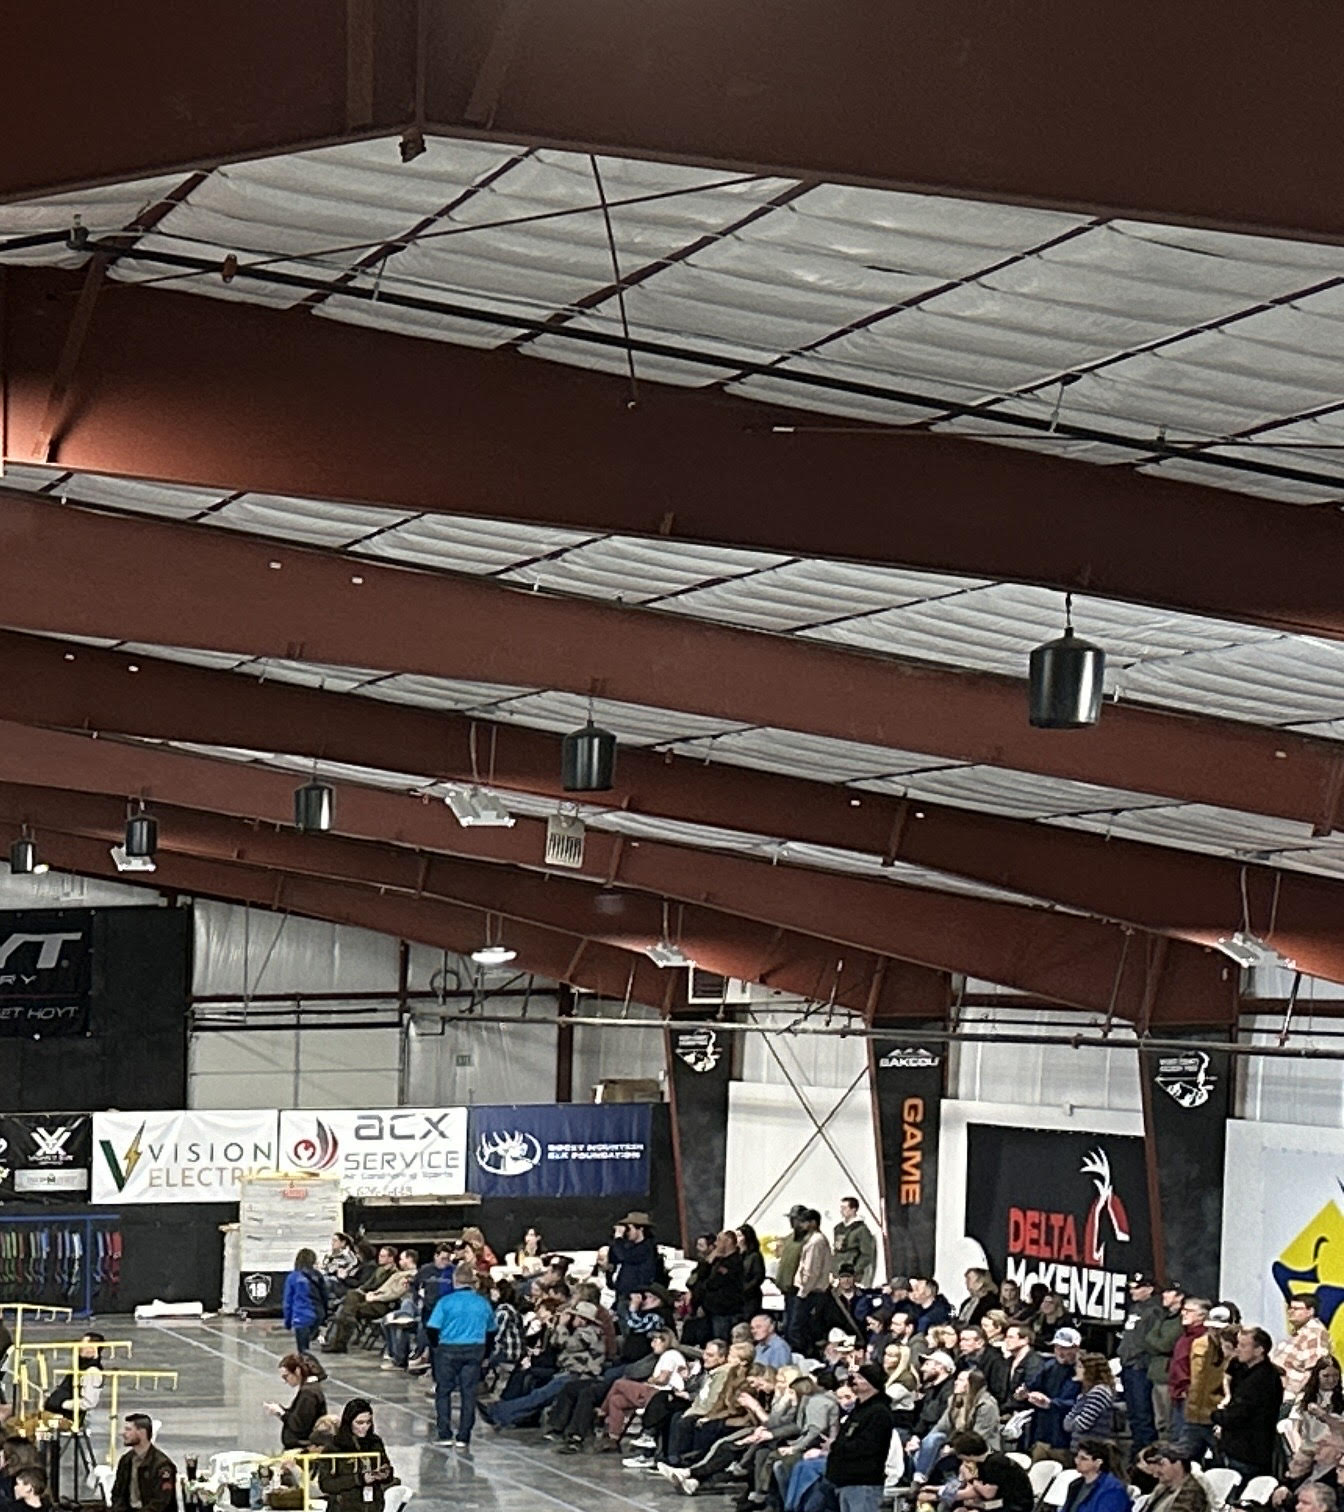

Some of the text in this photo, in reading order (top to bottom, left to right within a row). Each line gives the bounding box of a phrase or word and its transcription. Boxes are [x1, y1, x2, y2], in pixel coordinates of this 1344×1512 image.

[148, 1142, 272, 1162] VISION
[344, 1151, 460, 1170] SERVICE
[900, 1097, 924, 1205] GAME
[1008, 1207, 1077, 1262] DELTA
